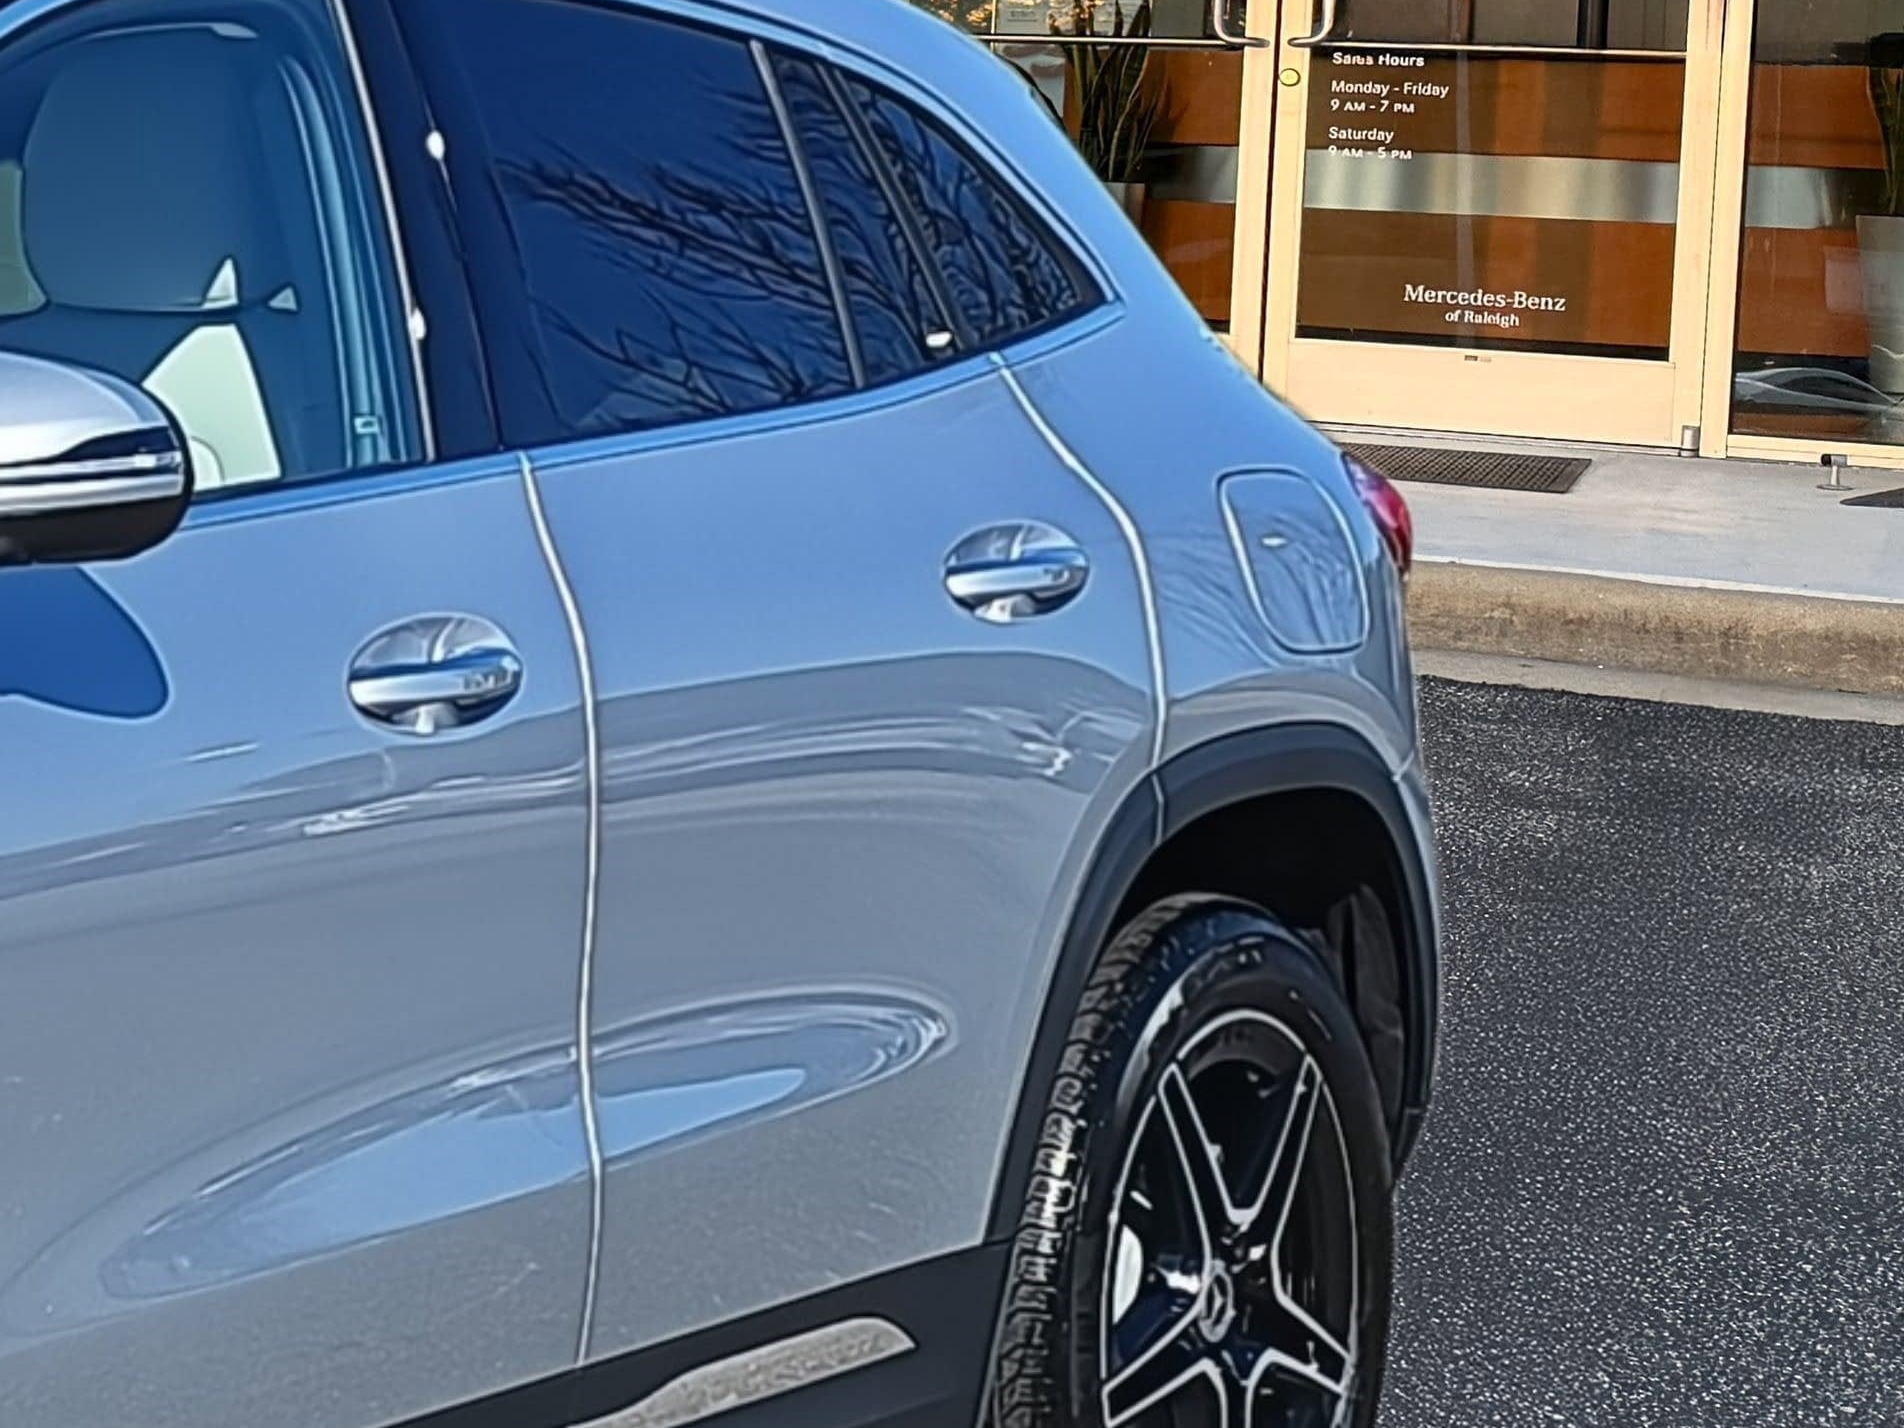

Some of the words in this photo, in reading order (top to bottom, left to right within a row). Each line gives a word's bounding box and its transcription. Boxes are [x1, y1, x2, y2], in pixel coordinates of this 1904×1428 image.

[1378, 53, 1425, 66] Hours
[1331, 80, 1390, 97] Monday
[1403, 82, 1449, 98] Friday
[1330, 99, 1340, 111] 9
[1344, 102, 1365, 111] AM
[1379, 100, 1389, 112] 7
[1394, 103, 1415, 113] PM
[1329, 127, 1394, 143] Saturday
[1328, 145, 1338, 157] 9
[1342, 148, 1364, 158] AM
[1377, 147, 1387, 159] 5
[1391, 150, 1412, 160] PM
[1404, 284, 1566, 312] Mercedes-Benz
[1445, 310, 1462, 322] of
[1464, 311, 1520, 328] Raleigh
